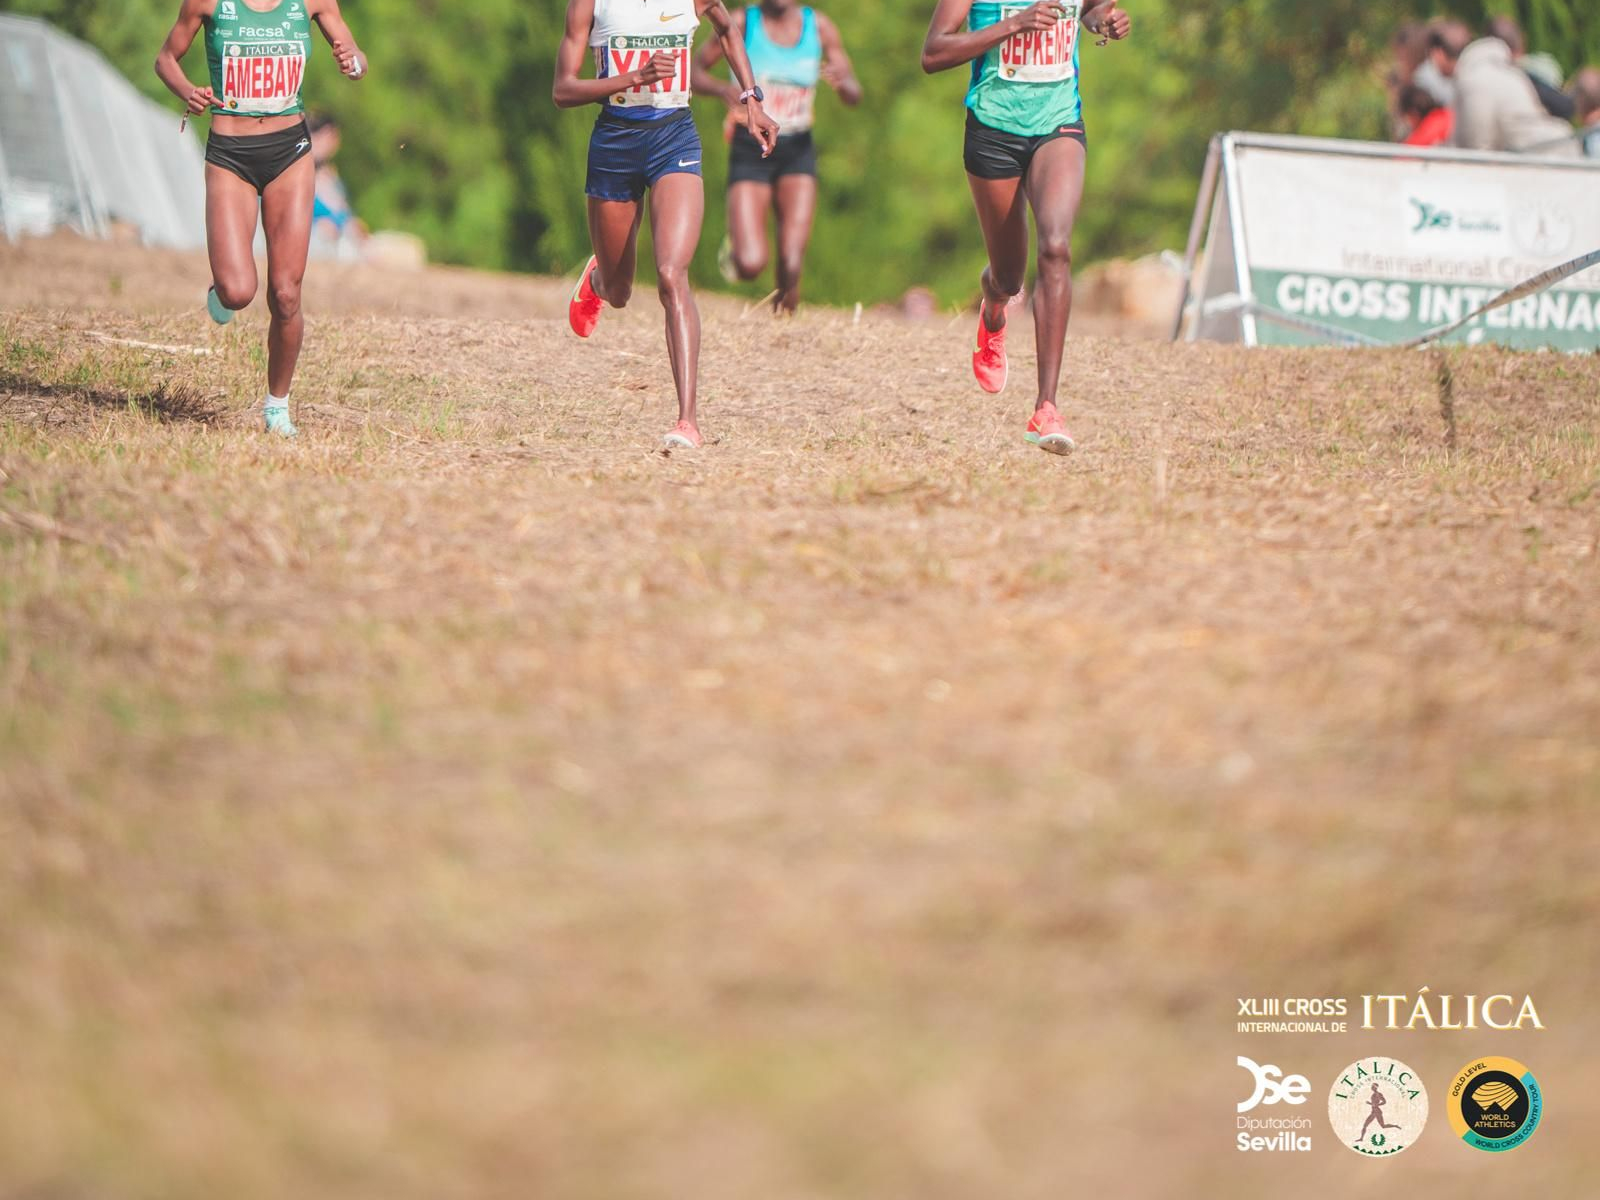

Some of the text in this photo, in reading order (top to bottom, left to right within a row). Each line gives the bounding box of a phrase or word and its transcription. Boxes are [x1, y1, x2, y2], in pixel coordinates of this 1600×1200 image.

[224, 56, 303, 98] AMEBAW
[611, 49, 687, 93] YAVI
[1277, 273, 1411, 321] CROSS
